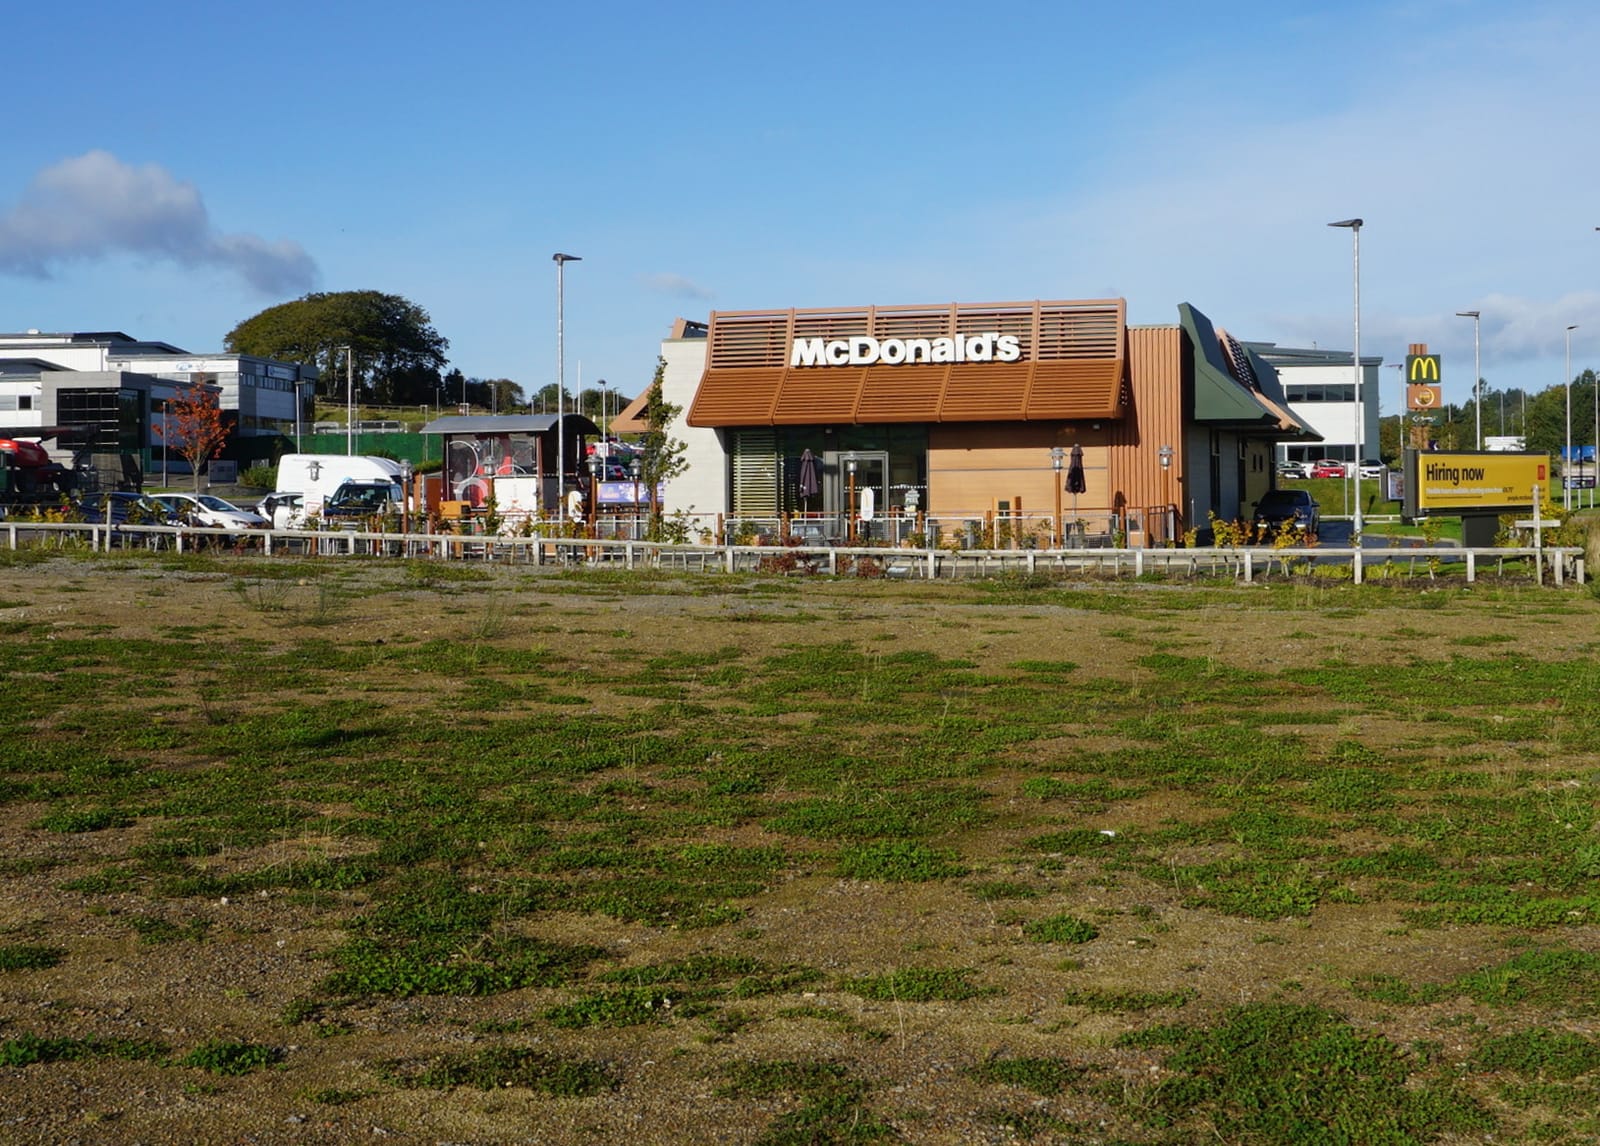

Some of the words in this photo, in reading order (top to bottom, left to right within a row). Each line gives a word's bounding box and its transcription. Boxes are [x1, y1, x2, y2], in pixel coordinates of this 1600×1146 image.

[790, 332, 1021, 367] McDonald's
[1426, 463, 1459, 486] Hiring
[1462, 467, 1484, 480] now
